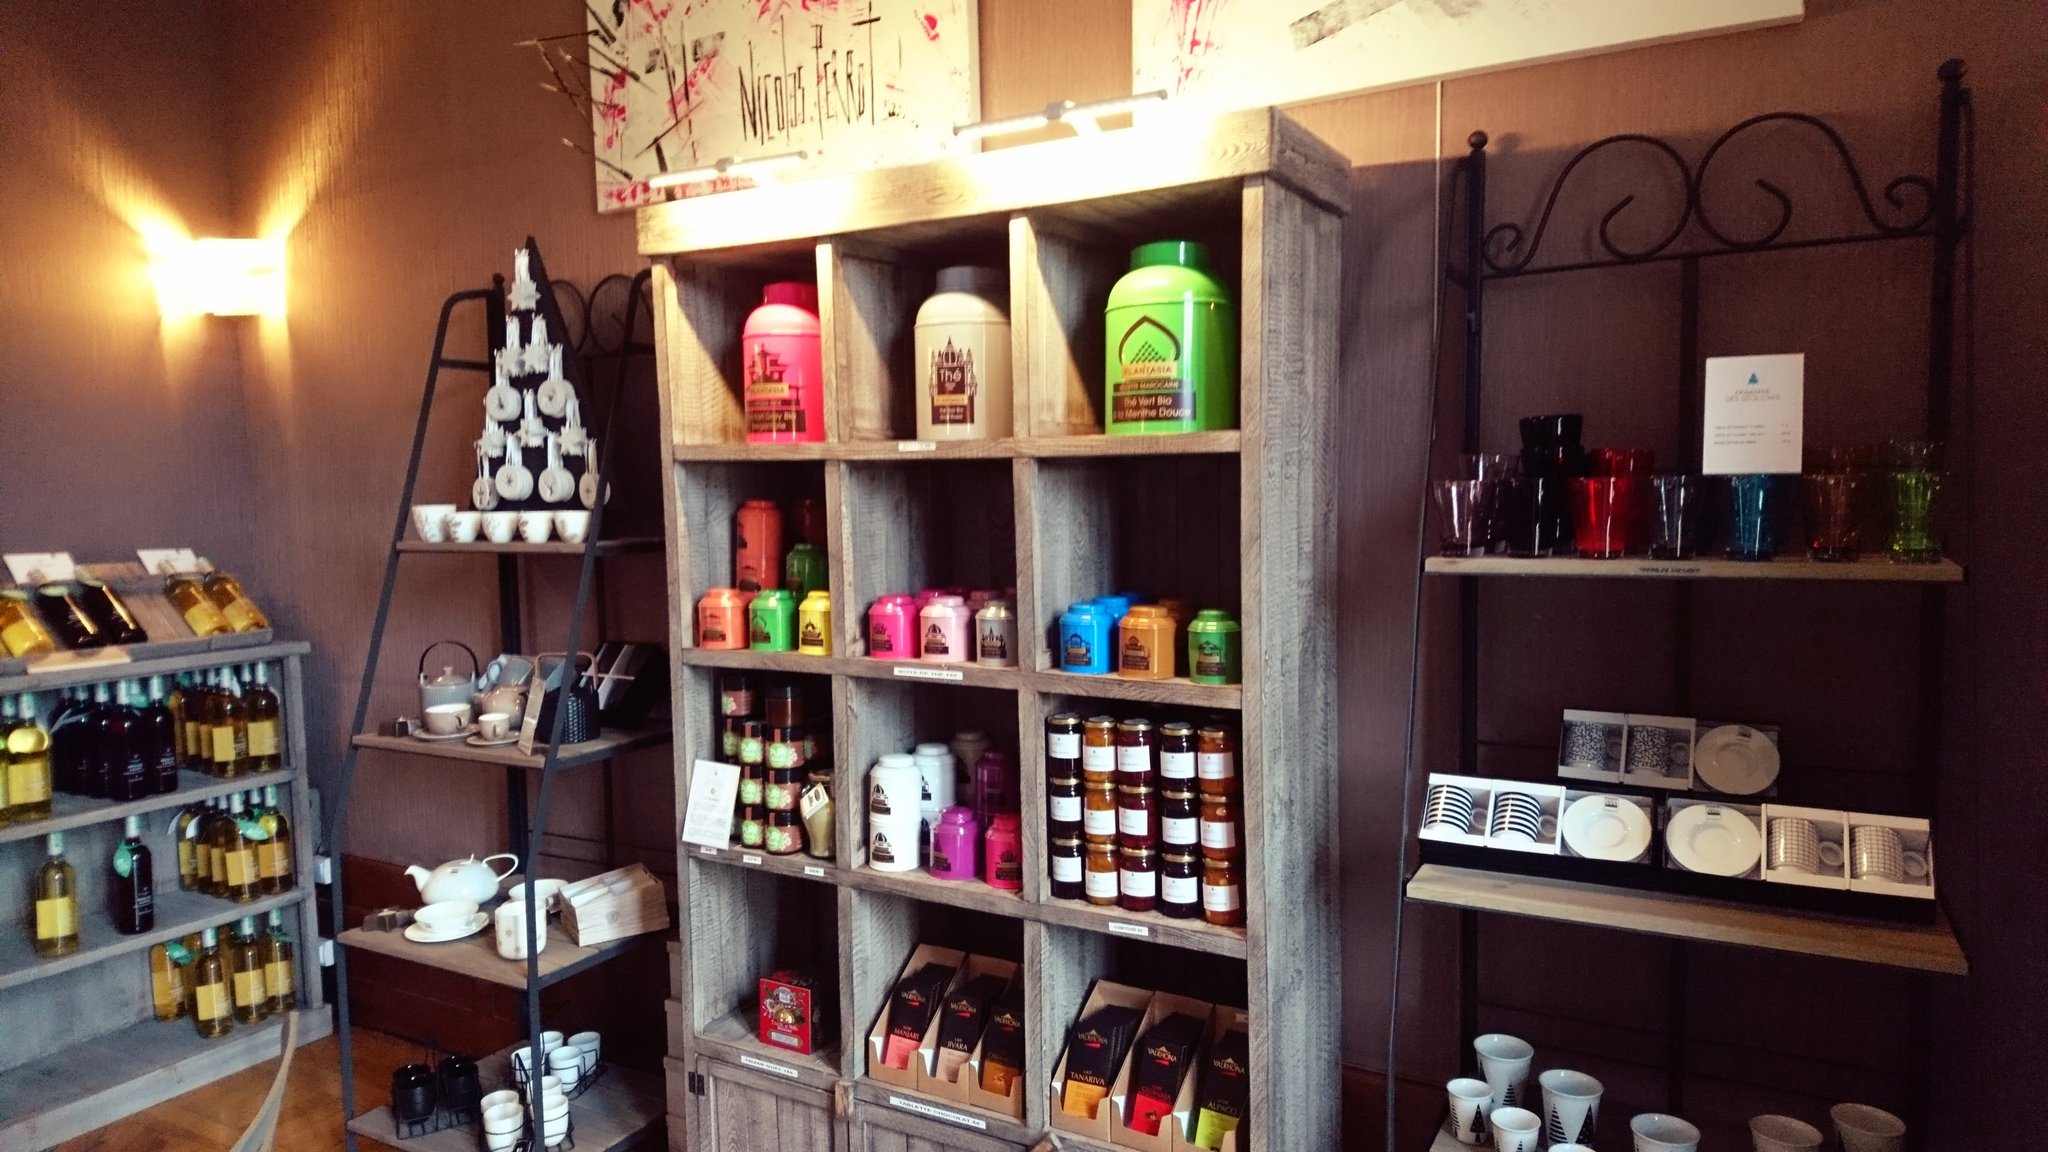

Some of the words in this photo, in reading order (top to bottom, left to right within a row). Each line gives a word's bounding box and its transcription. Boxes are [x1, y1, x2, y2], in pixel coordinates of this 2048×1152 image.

[939, 368, 962, 382] Thé
[1124, 396, 1137, 407] Thé
[1138, 396, 1156, 407] Vert
[1157, 395, 1173, 406] Bio
[1125, 408, 1157, 419] Menthe
[1159, 407, 1191, 418] Douce
[950, 1002, 977, 1014] VALRHONA
[893, 1027, 920, 1041] MANJARI
[947, 1040, 968, 1051] JIVARA
[1147, 1047, 1178, 1062] VALRHONA
[1213, 1059, 1246, 1075] VALRHONA
[1070, 1071, 1105, 1086] TANARIVA
